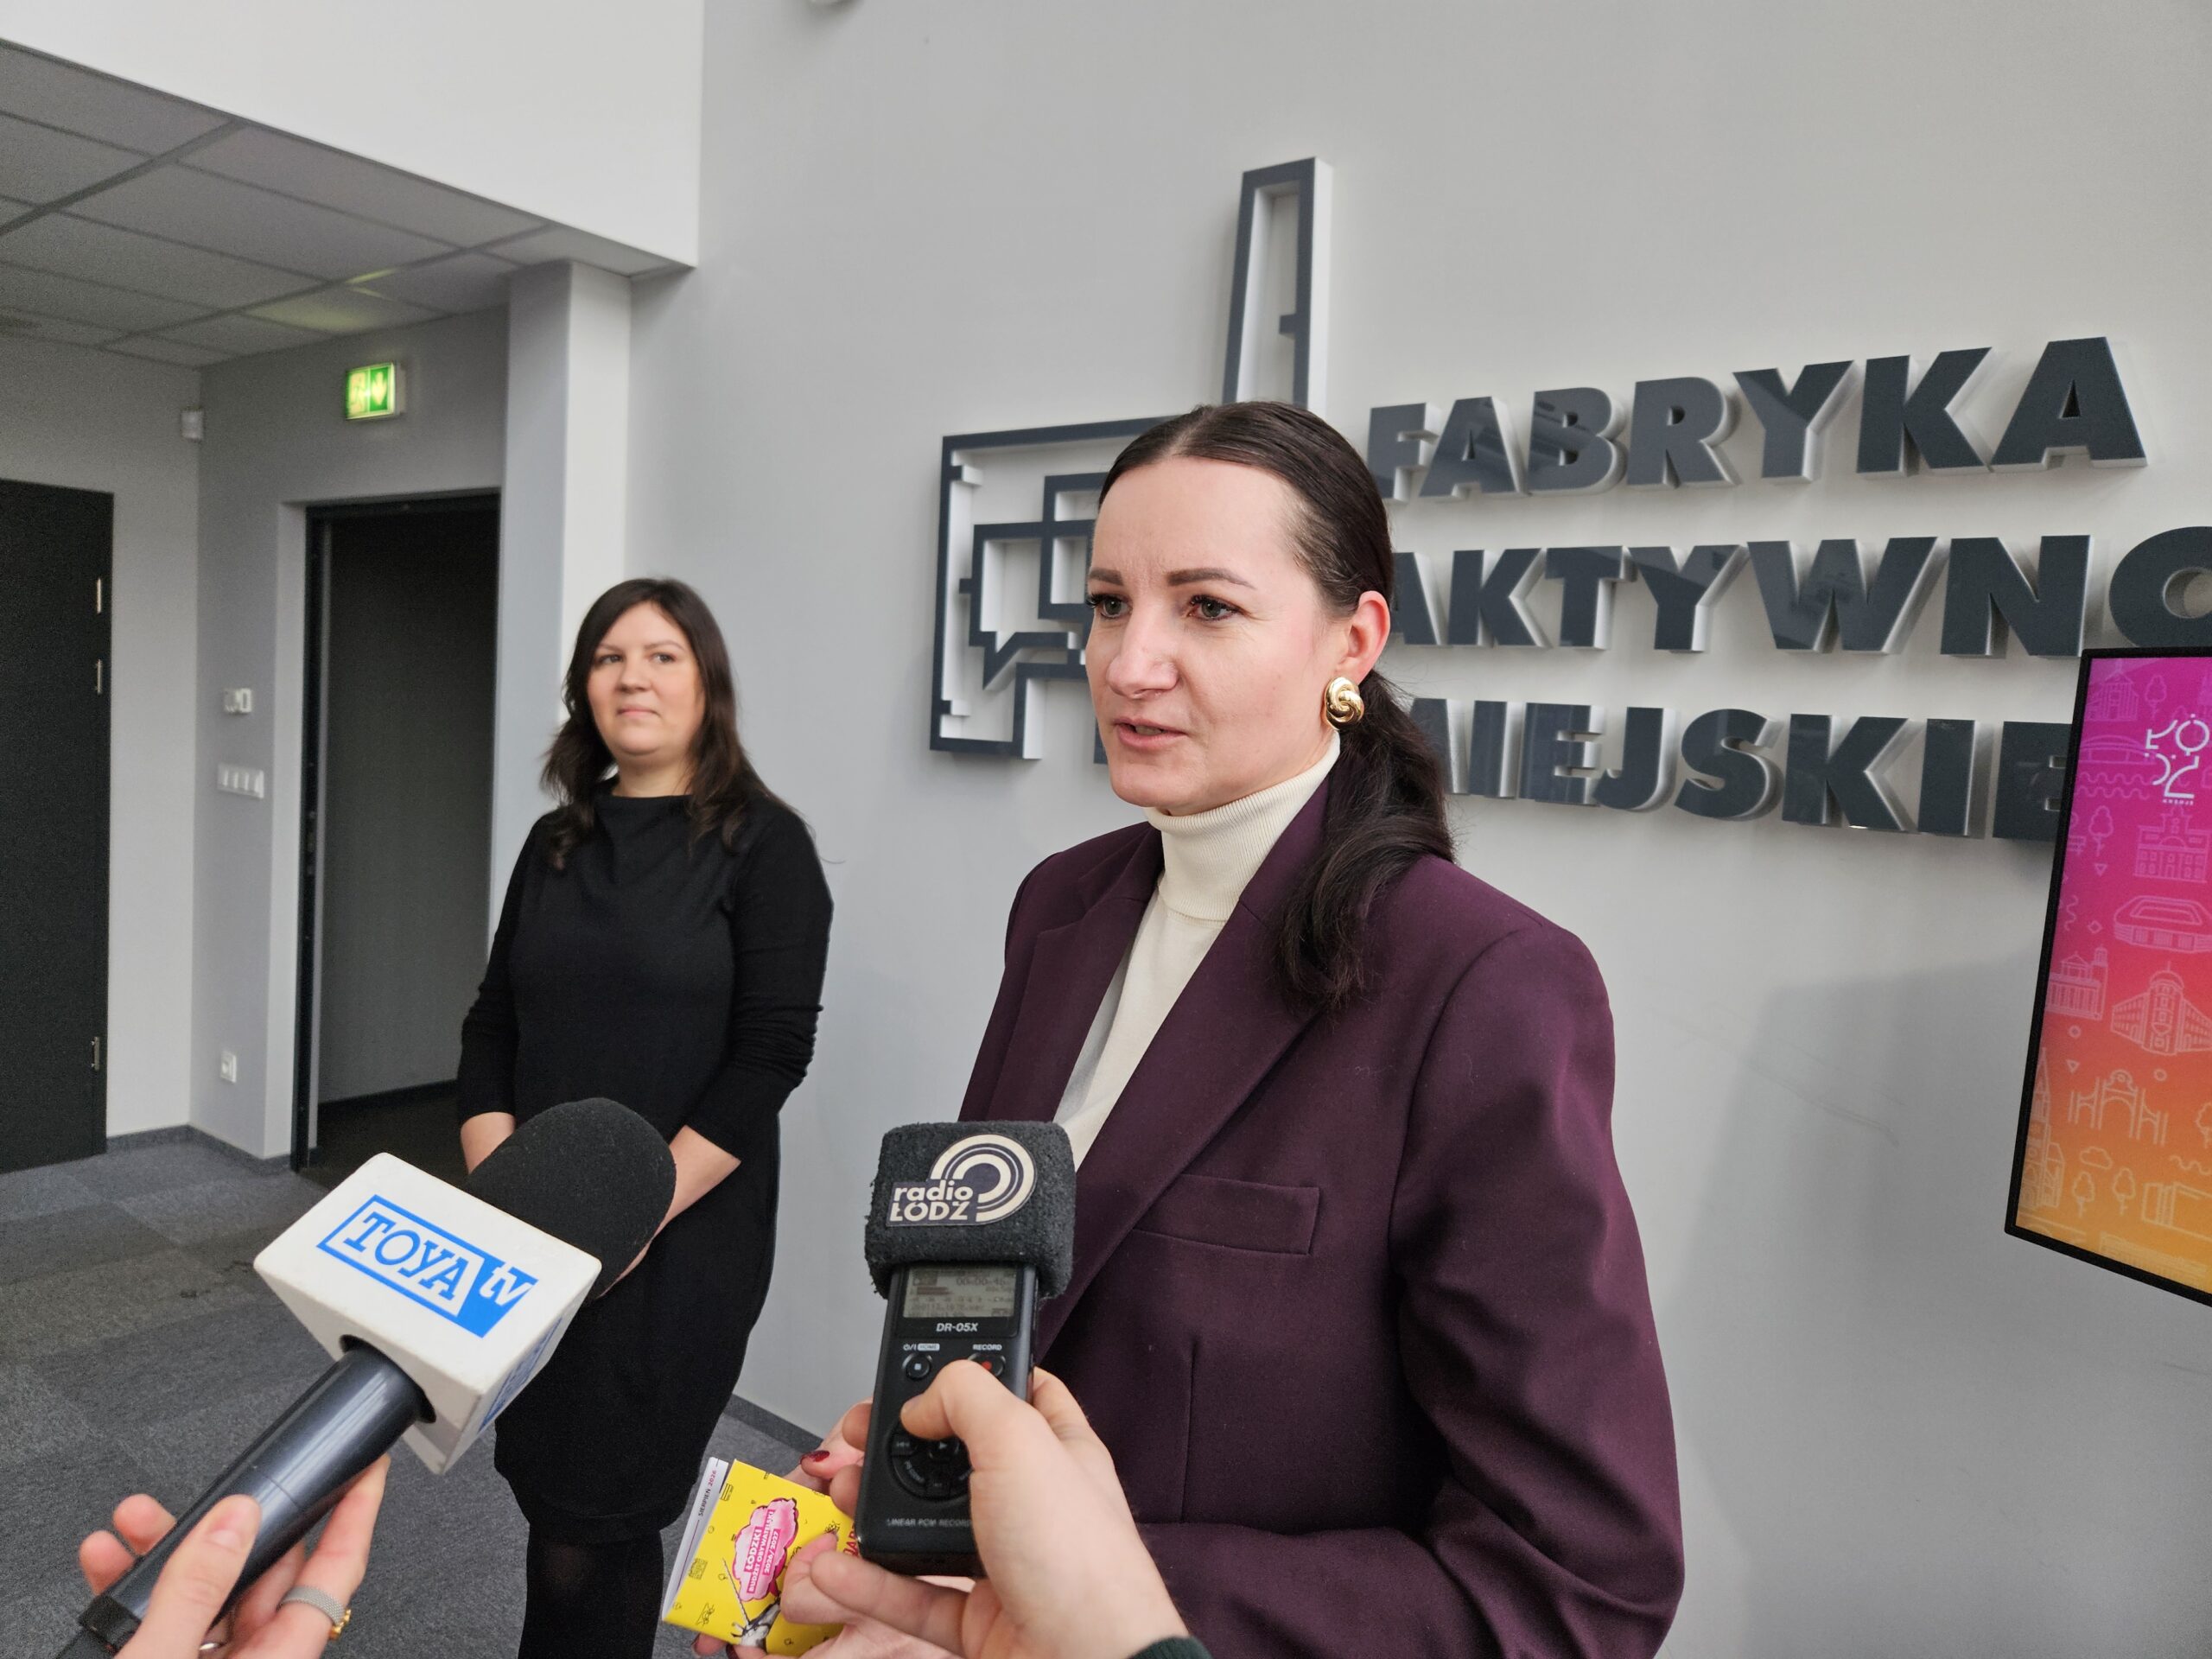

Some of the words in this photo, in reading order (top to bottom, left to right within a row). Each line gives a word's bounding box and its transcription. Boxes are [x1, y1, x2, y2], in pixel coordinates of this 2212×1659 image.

[1367, 337, 2147, 501] FABRYKA
[893, 1179, 974, 1201] radio
[343, 1211, 469, 1301] TOYA
[480, 1261, 531, 1306] tv
[936, 1322, 979, 1332] DR-05X
